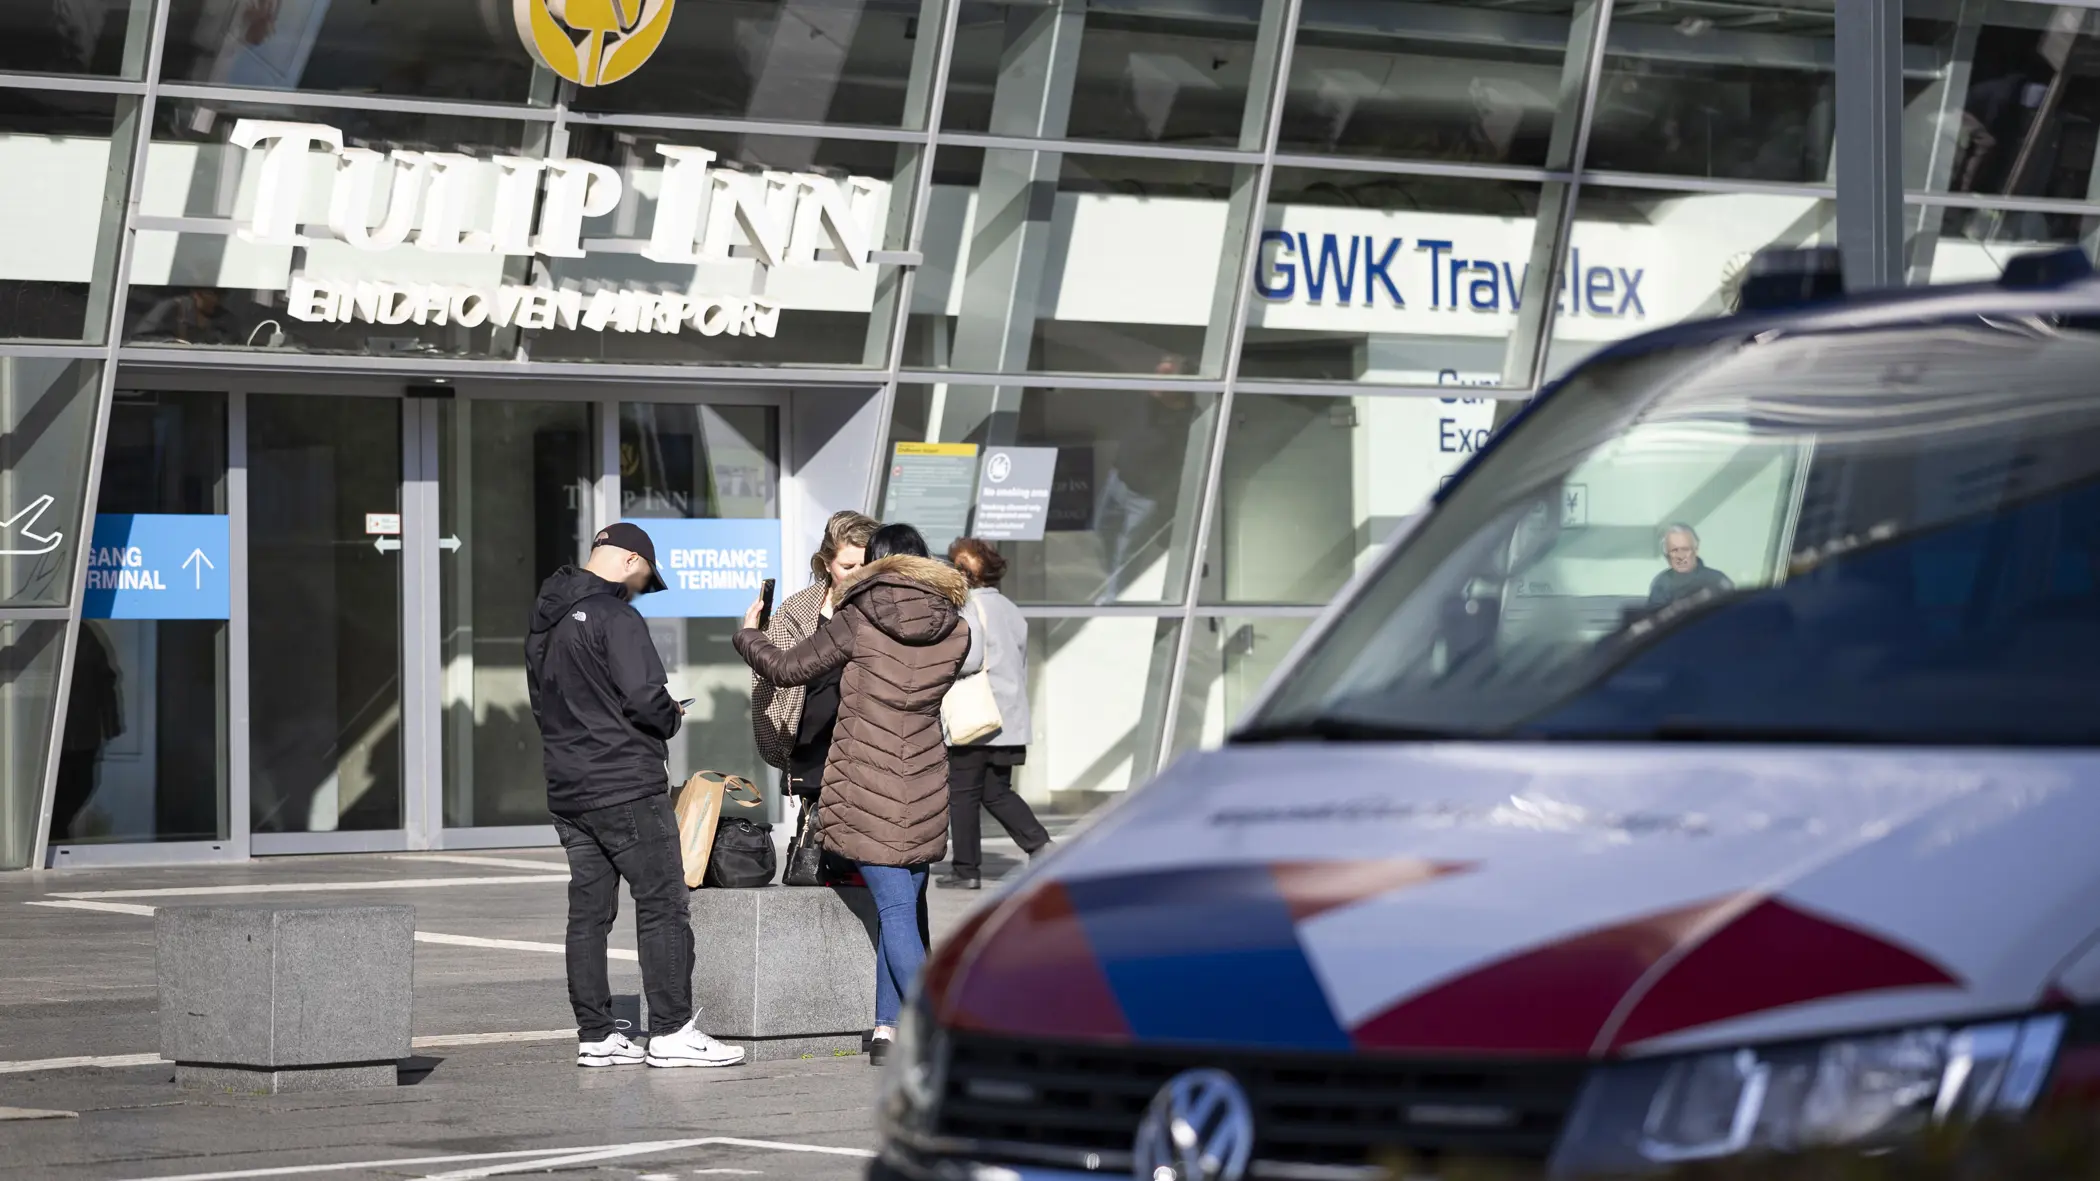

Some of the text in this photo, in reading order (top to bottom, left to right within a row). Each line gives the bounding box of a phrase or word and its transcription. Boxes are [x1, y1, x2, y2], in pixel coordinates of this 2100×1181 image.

[641, 143, 888, 271] INN
[1254, 229, 1646, 316] GWK Travlex
[288, 275, 780, 338] EINDHOVEN AIRPORT
[85, 569, 167, 590] RMINAL
[669, 548, 768, 569] ENTRANCE
